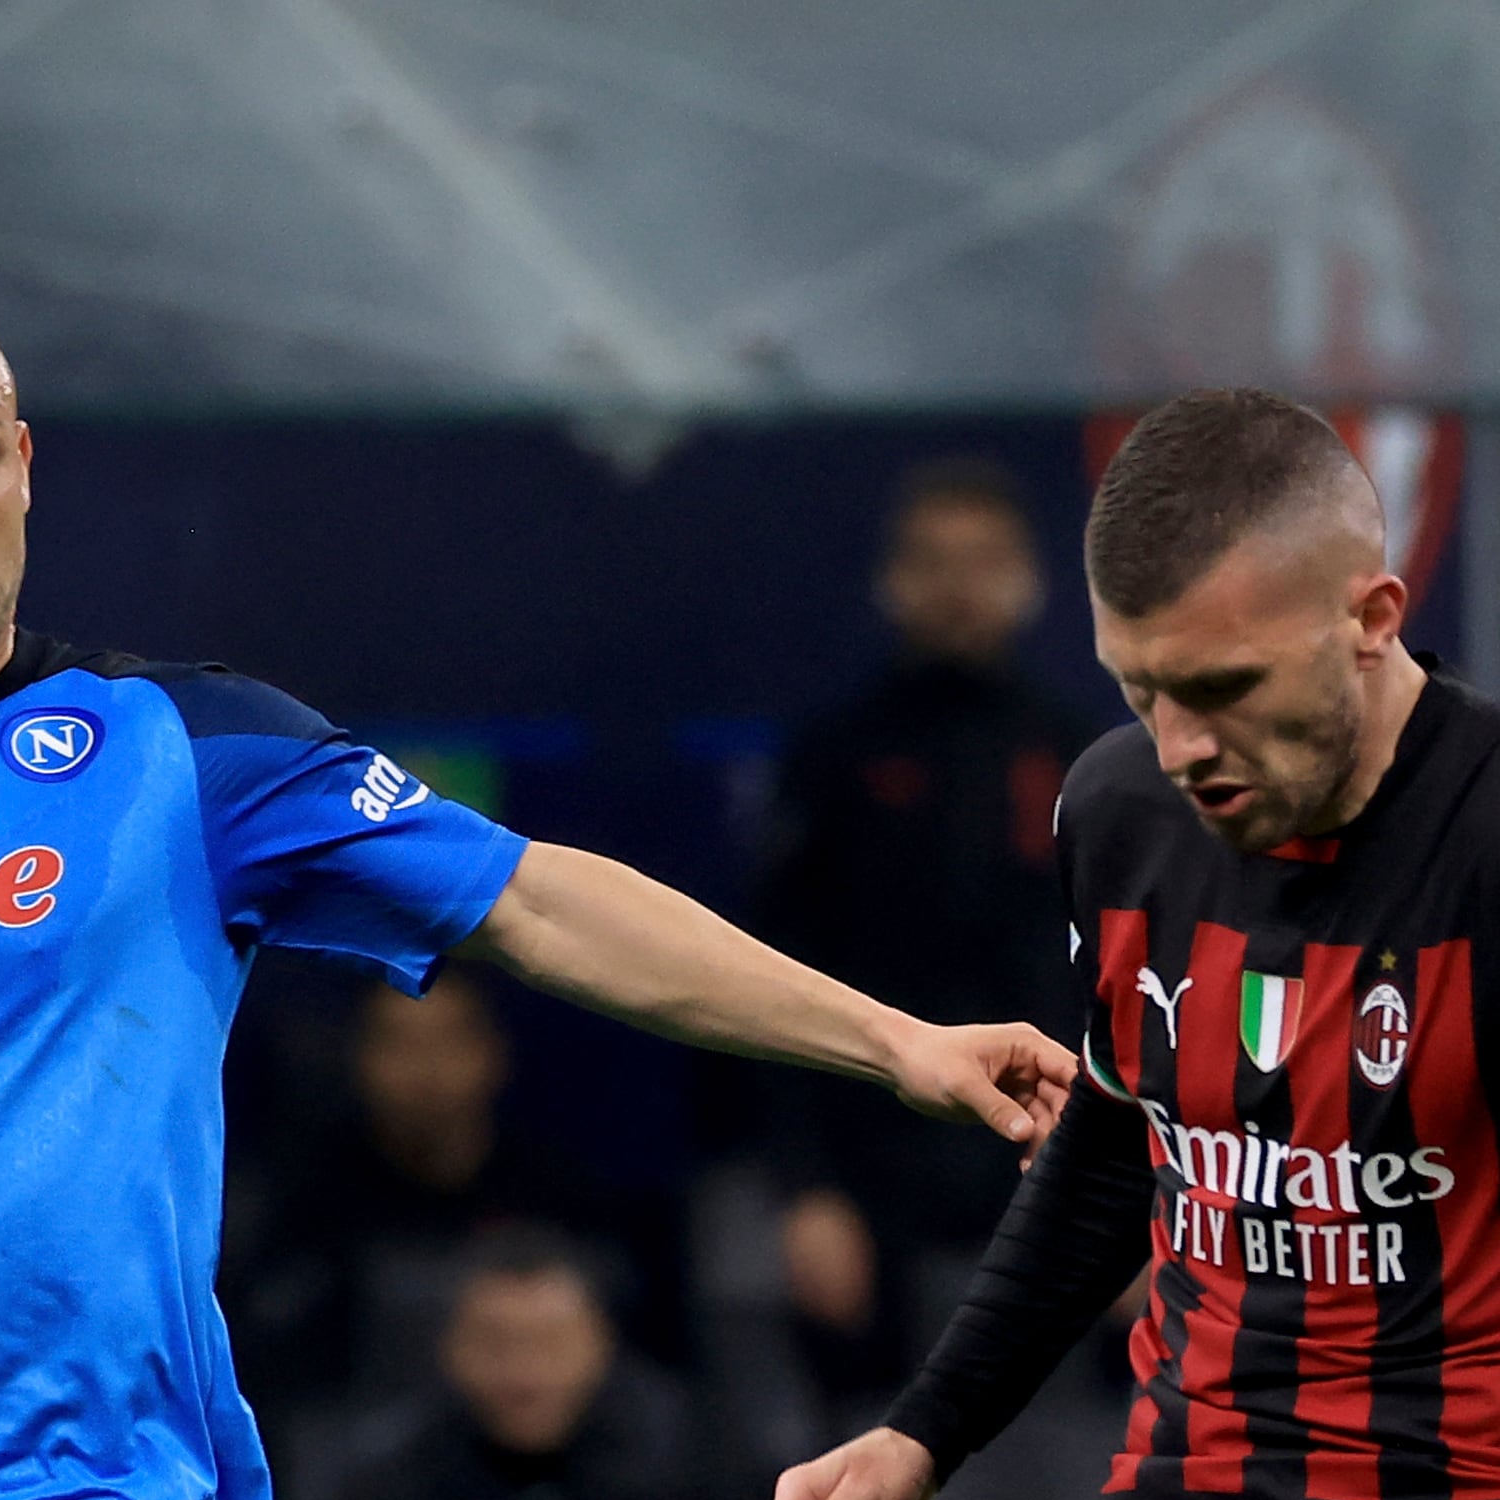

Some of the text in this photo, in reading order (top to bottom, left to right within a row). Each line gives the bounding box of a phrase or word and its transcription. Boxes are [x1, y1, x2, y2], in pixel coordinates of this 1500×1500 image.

[26, 724, 77, 763] N
[1138, 1097, 1456, 1214] Emirates
[1173, 1192, 1406, 1285] FLY BETTER
